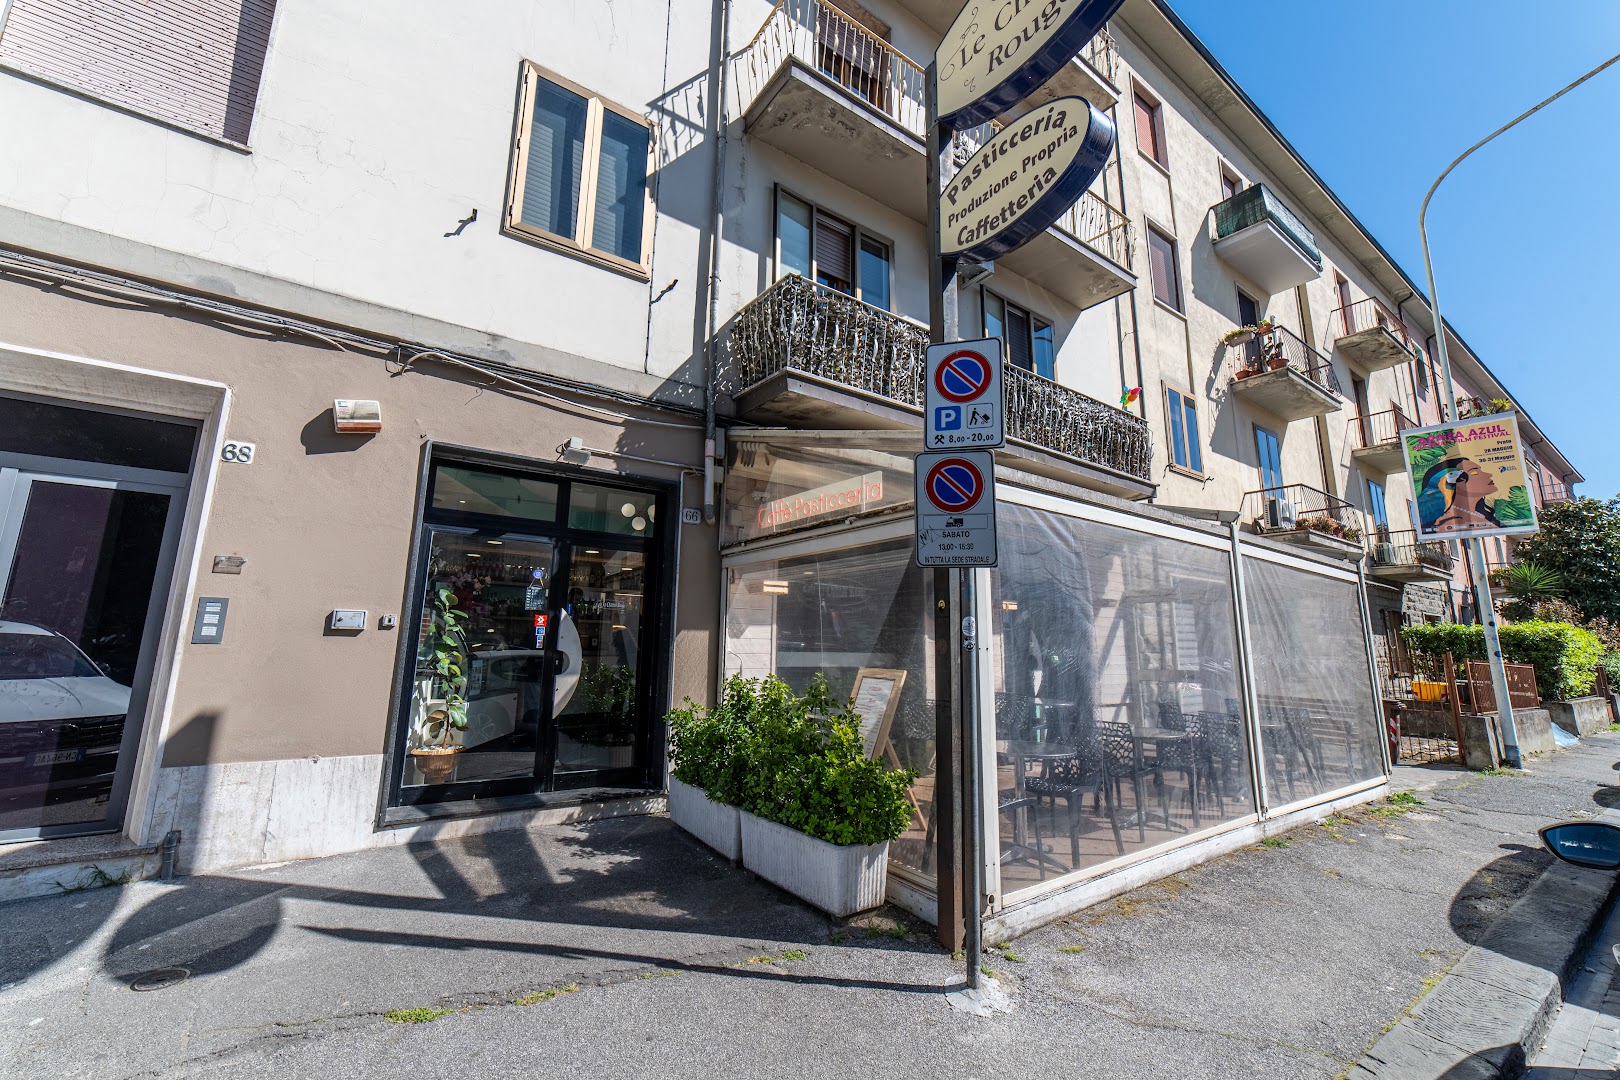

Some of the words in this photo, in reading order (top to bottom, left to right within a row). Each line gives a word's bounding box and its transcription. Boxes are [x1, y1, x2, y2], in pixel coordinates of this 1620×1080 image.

[985, 0, 1067, 76] Roug
[959, 33, 986, 70] Le
[946, 106, 1068, 206] Pasticceria
[948, 169, 1018, 229] Produzione
[1022, 124, 1078, 174] Propria
[957, 165, 1058, 247] Caffetteria
[940, 409, 956, 429] P
[1418, 430, 1465, 446] ARARA
[1468, 424, 1506, 438] AZUL
[1453, 436, 1472, 444] FILM
[1473, 431, 1511, 441] FESTIVAL
[221, 443, 251, 463] 68
[757, 499, 793, 527] Caffè
[795, 481, 882, 518] Pasticceria
[685, 510, 698, 522] 66
[941, 530, 971, 539] SABATO
[964, 555, 990, 563] STRADALE
